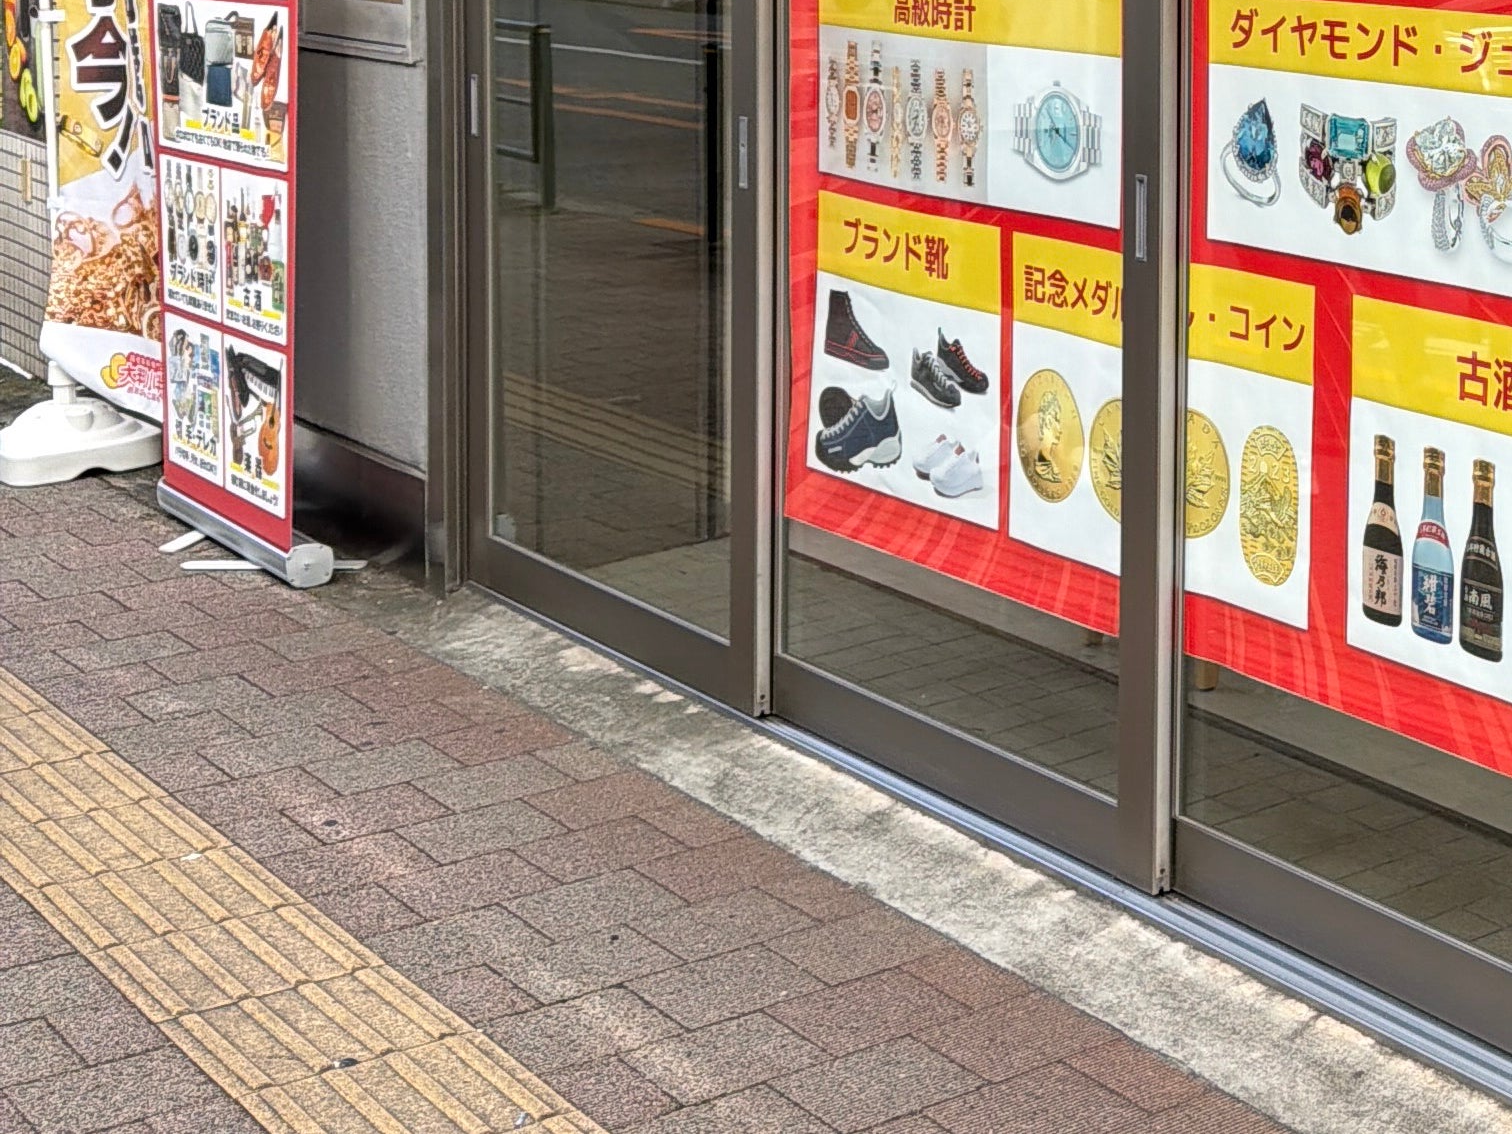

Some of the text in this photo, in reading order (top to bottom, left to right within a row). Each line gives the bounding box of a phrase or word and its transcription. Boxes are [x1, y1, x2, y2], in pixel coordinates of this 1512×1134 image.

[842, 218, 950, 280] ブランド靴
